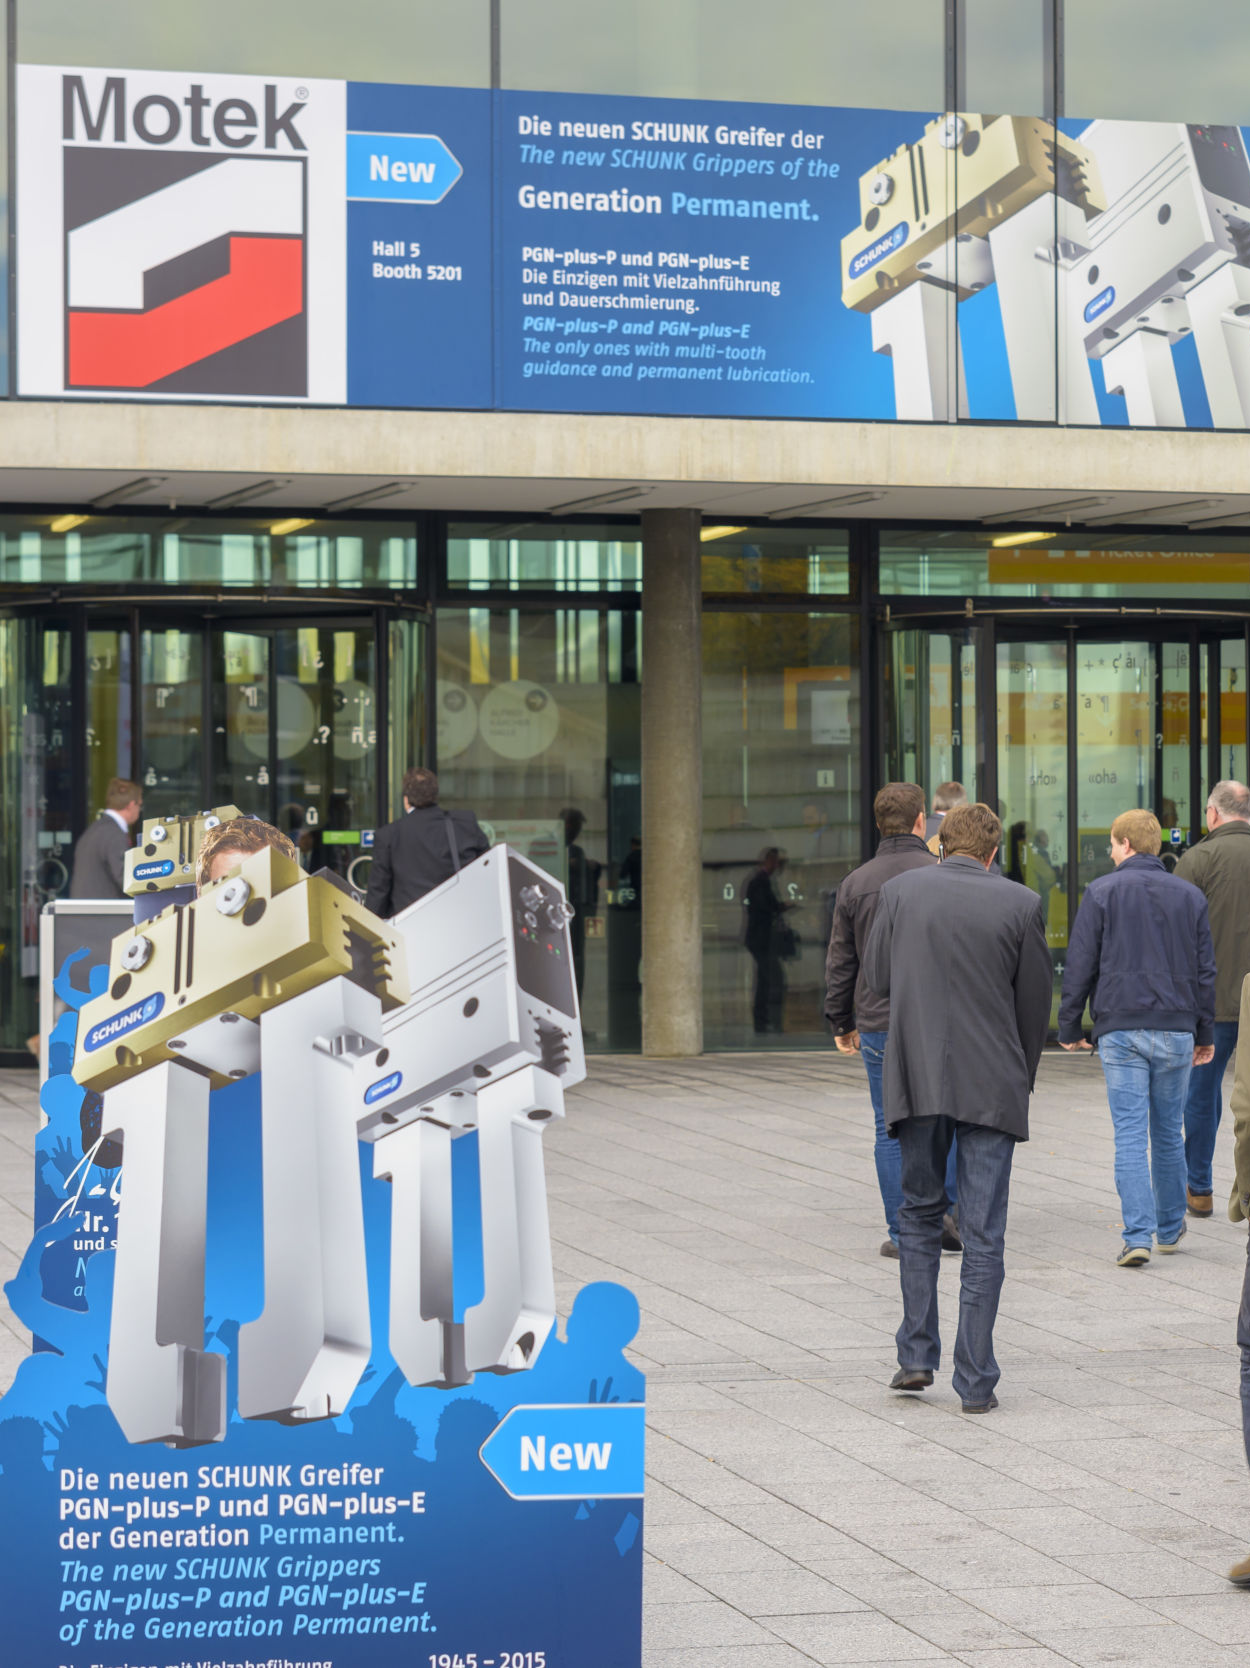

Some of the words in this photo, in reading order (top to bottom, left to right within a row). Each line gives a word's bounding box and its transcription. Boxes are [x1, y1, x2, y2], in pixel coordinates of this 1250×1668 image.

[518, 116, 552, 136] Die
[559, 121, 625, 139] neuen
[631, 122, 709, 144] SCHUNK
[715, 126, 784, 147] Greifer
[791, 130, 824, 149] der
[369, 154, 436, 184] New
[520, 145, 555, 164] The
[561, 149, 606, 167] new
[610, 149, 687, 171] SCHUNK
[693, 153, 775, 177] Grippers
[781, 157, 804, 180] of
[807, 159, 840, 178] the
[518, 185, 662, 214] Generation
[671, 192, 819, 221] Permanent.
[372, 240, 405, 258] Hall
[410, 243, 421, 258] 5
[522, 246, 617, 266] PGN-plus-P
[621, 252, 652, 267] und
[658, 252, 750, 271] PGN-plus-E
[854, 235, 893, 272] SCHUNK
[372, 262, 422, 281] Booth
[426, 265, 463, 281] 5201
[522, 268, 547, 284] Die
[553, 270, 617, 289] Einzigen
[623, 272, 650, 288] mit
[653, 273, 781, 296] Vielzahnführung
[523, 291, 554, 307] und
[559, 291, 700, 314] Dauerschmierung.
[523, 316, 617, 336] PGN-plus-P
[622, 320, 654, 336] and
[658, 320, 750, 340] PGN-plus-E
[524, 338, 551, 354] The
[555, 339, 590, 358] only
[593, 342, 630, 357] ones
[634, 341, 670, 358] with
[675, 343, 766, 361] multi-tooth
[523, 360, 597, 379] guidance
[601, 362, 632, 378] and
[637, 364, 723, 382] permanent
[727, 366, 815, 385] lubrication.
[92, 1007, 143, 1044] SCHUNK
[74, 1236, 105, 1250] und
[520, 1434, 612, 1472] New
[60, 1467, 99, 1491] Die
[109, 1470, 188, 1490] neuen
[198, 1465, 291, 1489] SCHUNK
[300, 1463, 384, 1486] Greifer
[60, 1496, 210, 1524] PGN-plus-P
[219, 1494, 268, 1517] und
[279, 1491, 426, 1520] PGN-plus-E
[59, 1527, 101, 1550] der
[110, 1524, 249, 1548] Generation
[260, 1522, 405, 1545] Permanent.
[60, 1560, 104, 1583] The
[113, 1563, 168, 1582] new
[174, 1557, 270, 1580] SCHUNK
[277, 1555, 381, 1582] Grippers
[59, 1587, 212, 1616] PGN-plus-P
[219, 1585, 270, 1609] and
[278, 1582, 427, 1611] PGN-plus-E
[59, 1619, 89, 1647] of
[94, 1618, 135, 1641] the
[144, 1614, 283, 1640] Generation
[293, 1611, 438, 1636] Permanent.
